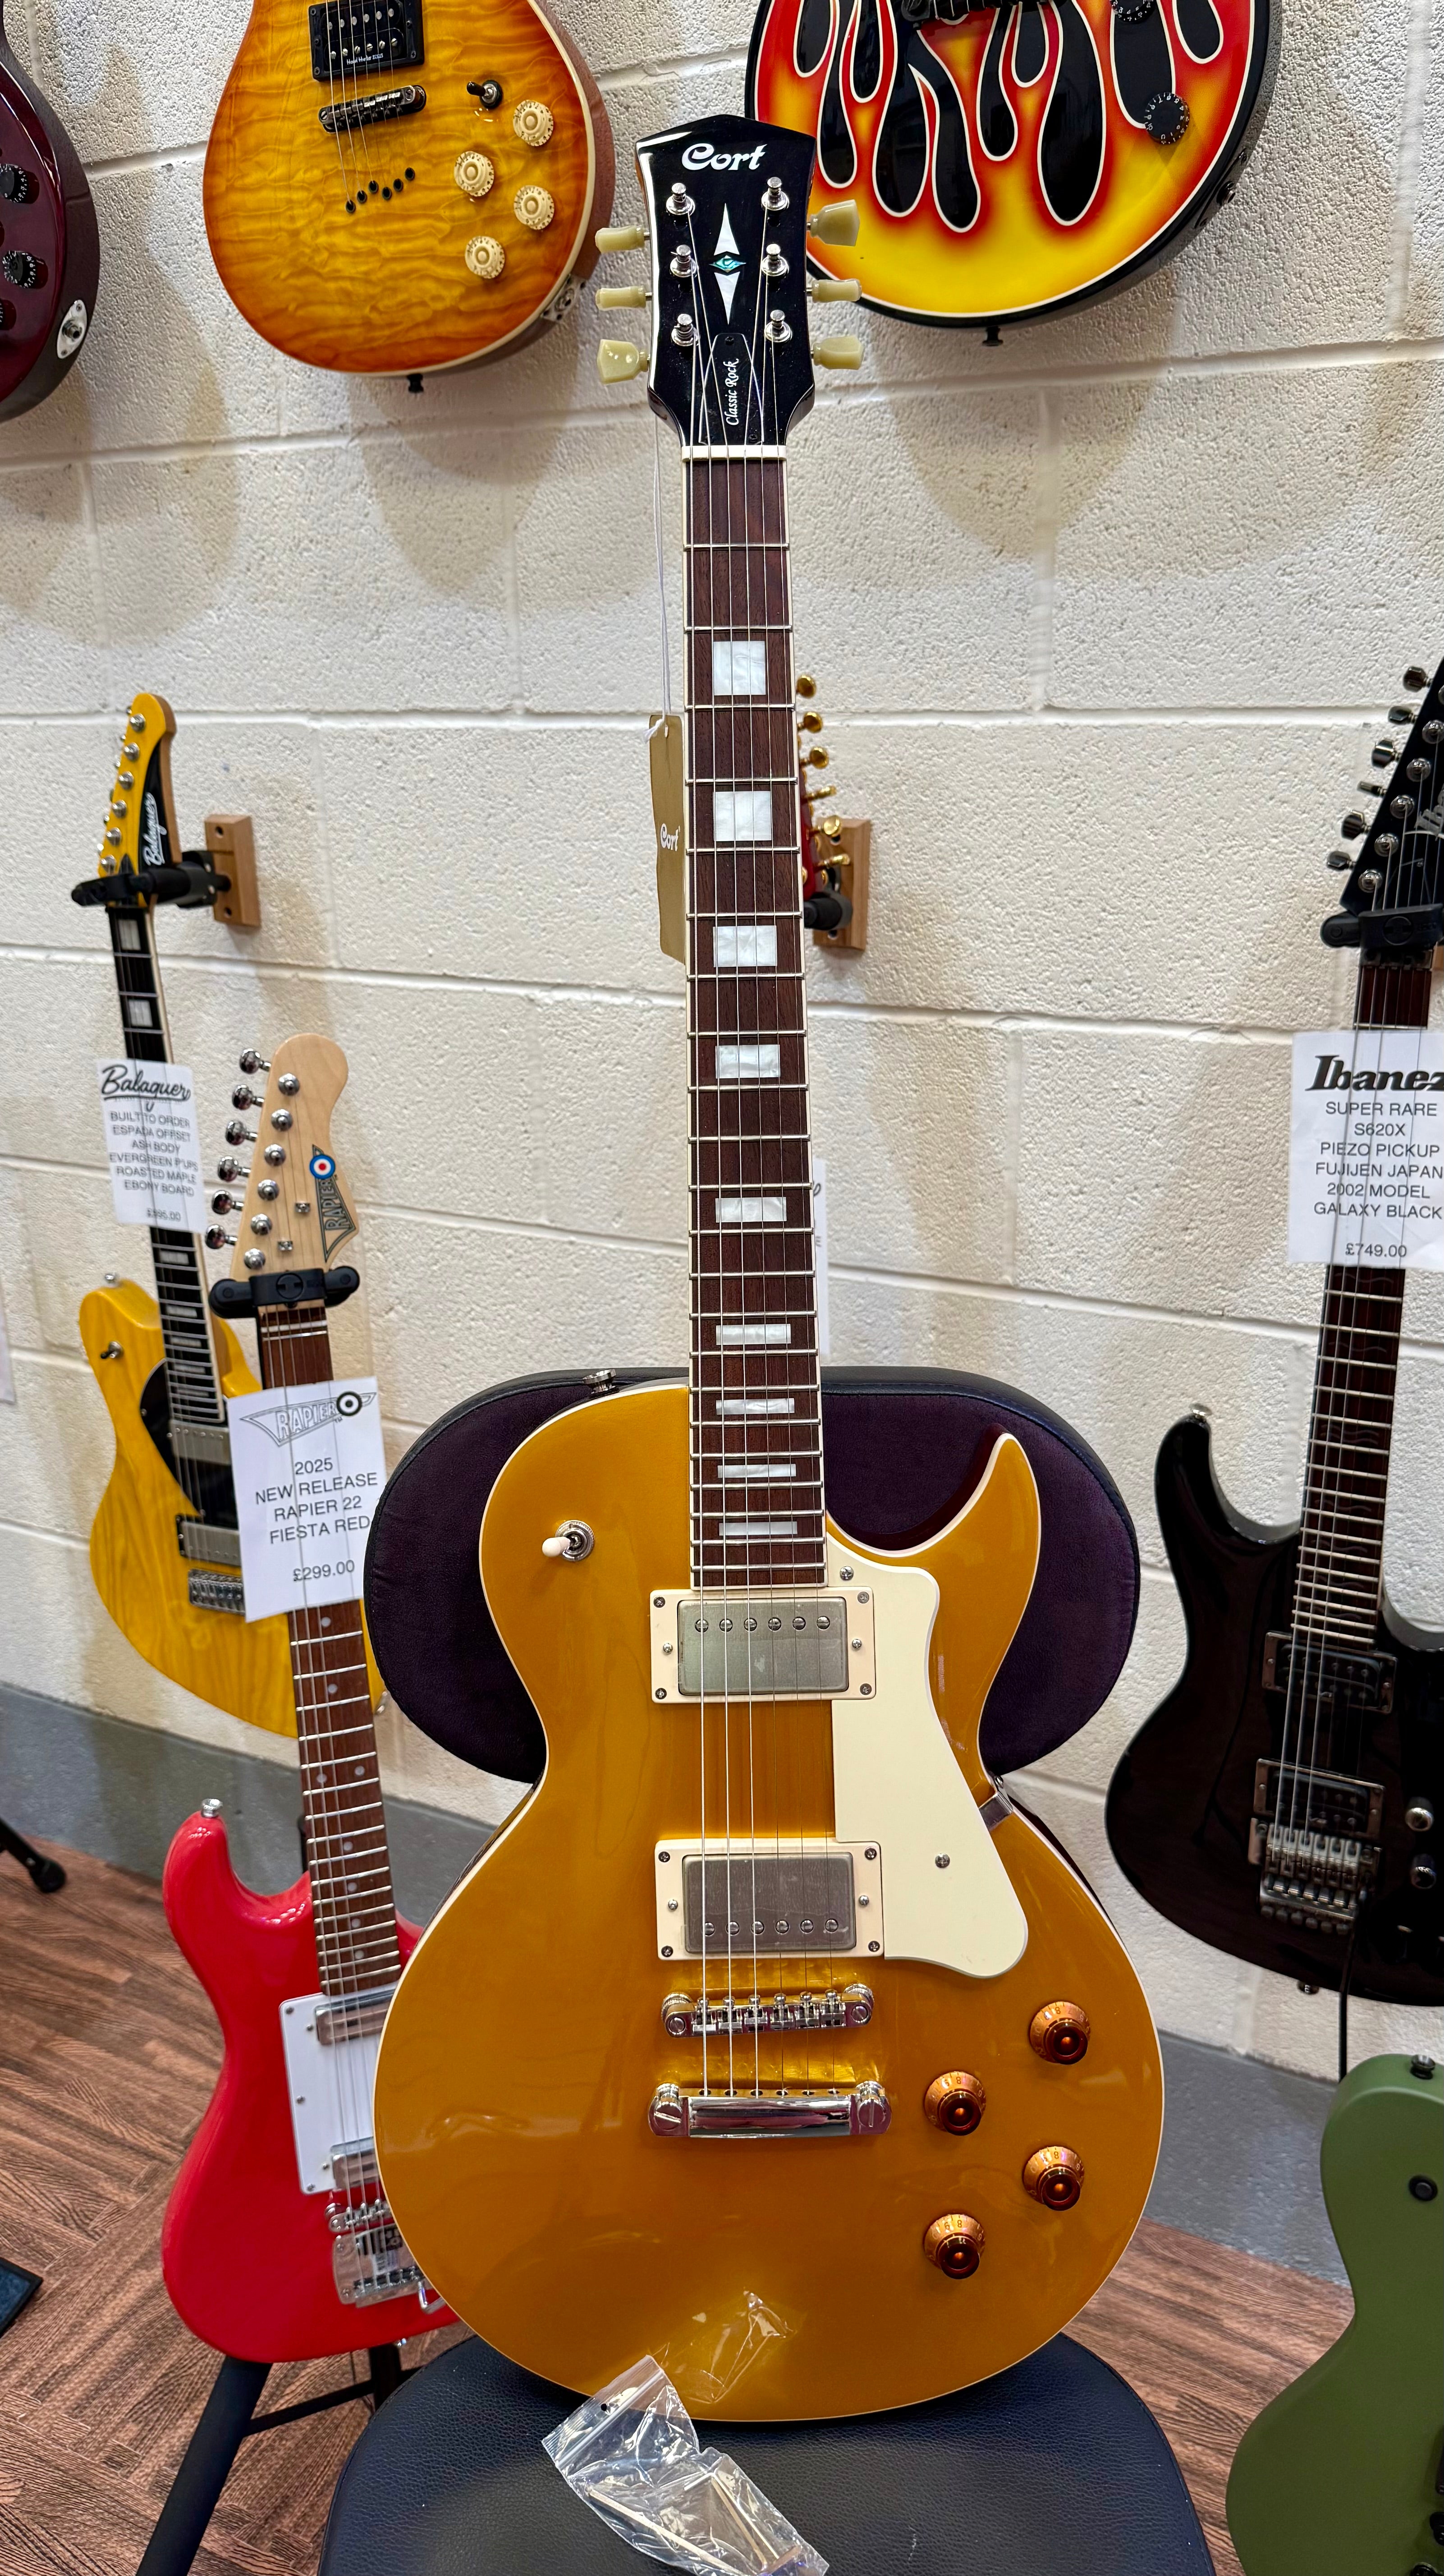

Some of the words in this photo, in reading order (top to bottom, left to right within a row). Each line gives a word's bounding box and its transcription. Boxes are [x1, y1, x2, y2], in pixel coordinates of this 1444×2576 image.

[681, 143, 767, 170] Cort
[724, 358, 739, 387] Rock
[725, 388, 739, 426] Classic
[660, 823, 680, 851] Cort
[1305, 1054, 1444, 1091] Ibanez
[101, 1065, 191, 1112] Balaguer
[1325, 1101, 1383, 1116] SUPER
[1389, 1103, 1437, 1117] RARE
[110, 1111, 141, 1122] BUILT
[159, 1114, 190, 1128] ORDER
[156, 1128, 191, 1142] OFFSET
[1354, 1122, 1406, 1136] S620X
[154, 1141, 180, 1154] BODY
[1320, 1142, 1370, 1156] PIEZO
[1375, 1143, 1440, 1157] PICKUP
[110, 1152, 172, 1167] EVERGREEN
[116, 1166, 165, 1180] ROASTED
[167, 1171, 197, 1185] MAPLE
[1388, 1165, 1443, 1179] JAPAN
[161, 1182, 194, 1197] BOARD
[1327, 1182, 1364, 1196] 2002
[1369, 1184, 1430, 1199] MODEL
[321, 1179, 350, 1230] RAPIER
[1314, 1202, 1380, 1217] GALAXY
[1386, 1204, 1443, 1219] BLACK
[1345, 1243, 1407, 1258] £749.00
[275, 1402, 337, 1440] RAPIER
[294, 1458, 333, 1475] 2025
[255, 1484, 293, 1505] NEW
[298, 1472, 378, 1497] RELEASE
[274, 1499, 338, 1522] RAPIER
[342, 1495, 362, 1510] 22
[270, 1522, 330, 1544] FIESTA
[335, 1515, 370, 1533] RED
[293, 1559, 355, 1582] £299.00
